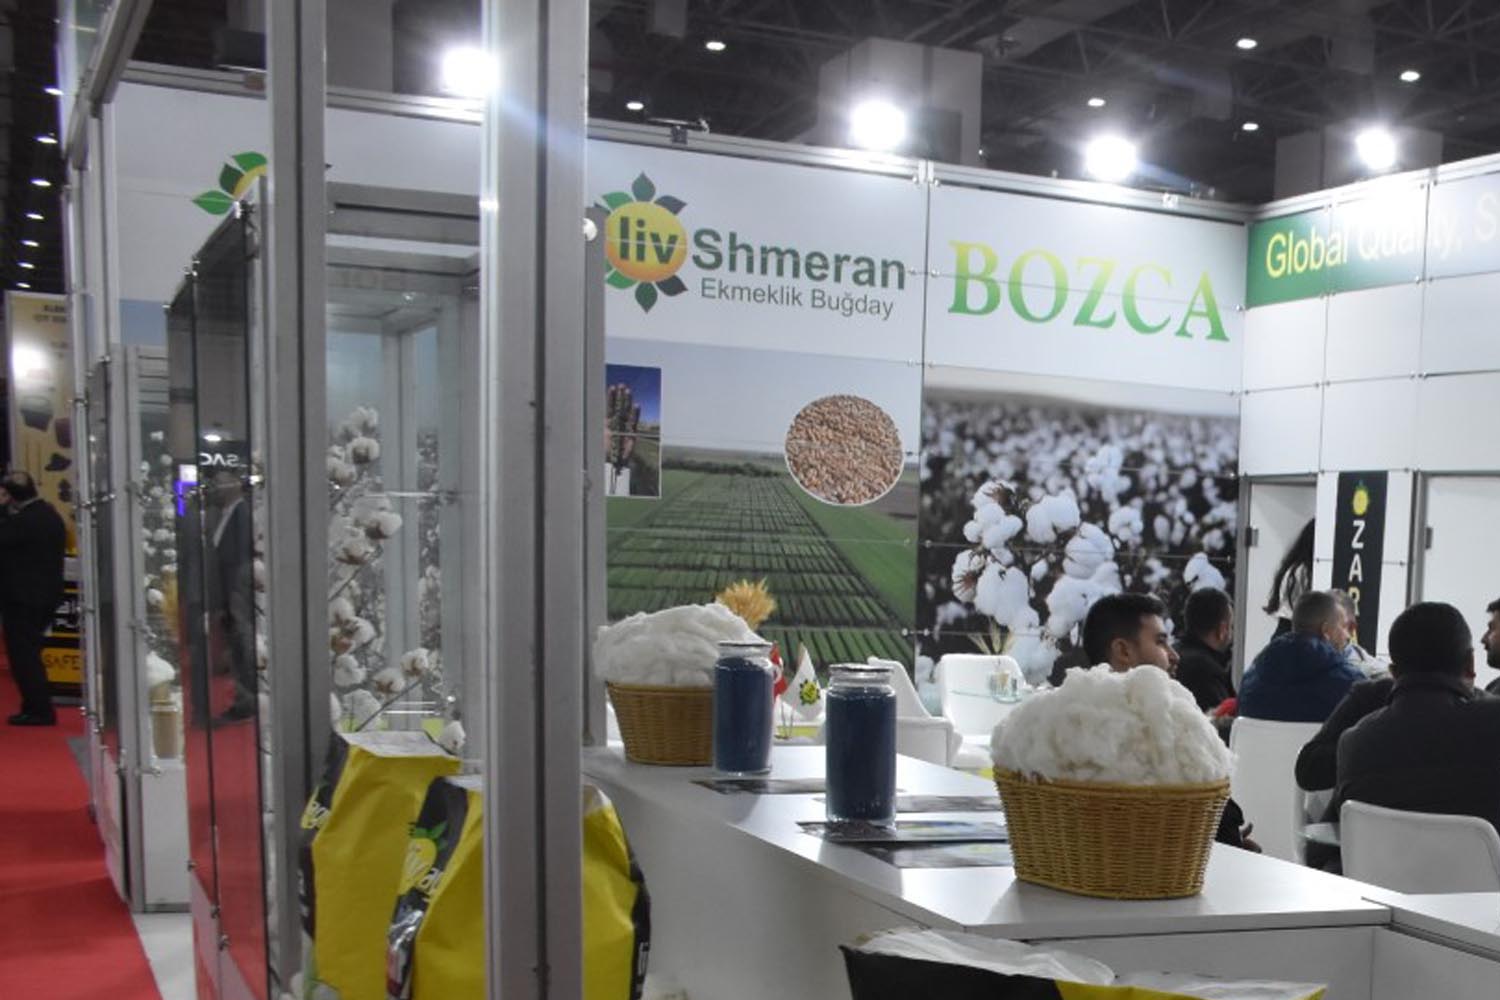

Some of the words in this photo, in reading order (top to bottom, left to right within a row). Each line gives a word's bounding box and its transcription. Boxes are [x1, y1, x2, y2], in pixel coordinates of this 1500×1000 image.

[619, 217, 679, 264] liv
[692, 229, 907, 292] Shmeran
[1266, 226, 1348, 278] Global
[701, 277, 804, 308] Ekmeklik
[810, 289, 895, 322] Buğday
[947, 240, 1230, 343] BOZCA
